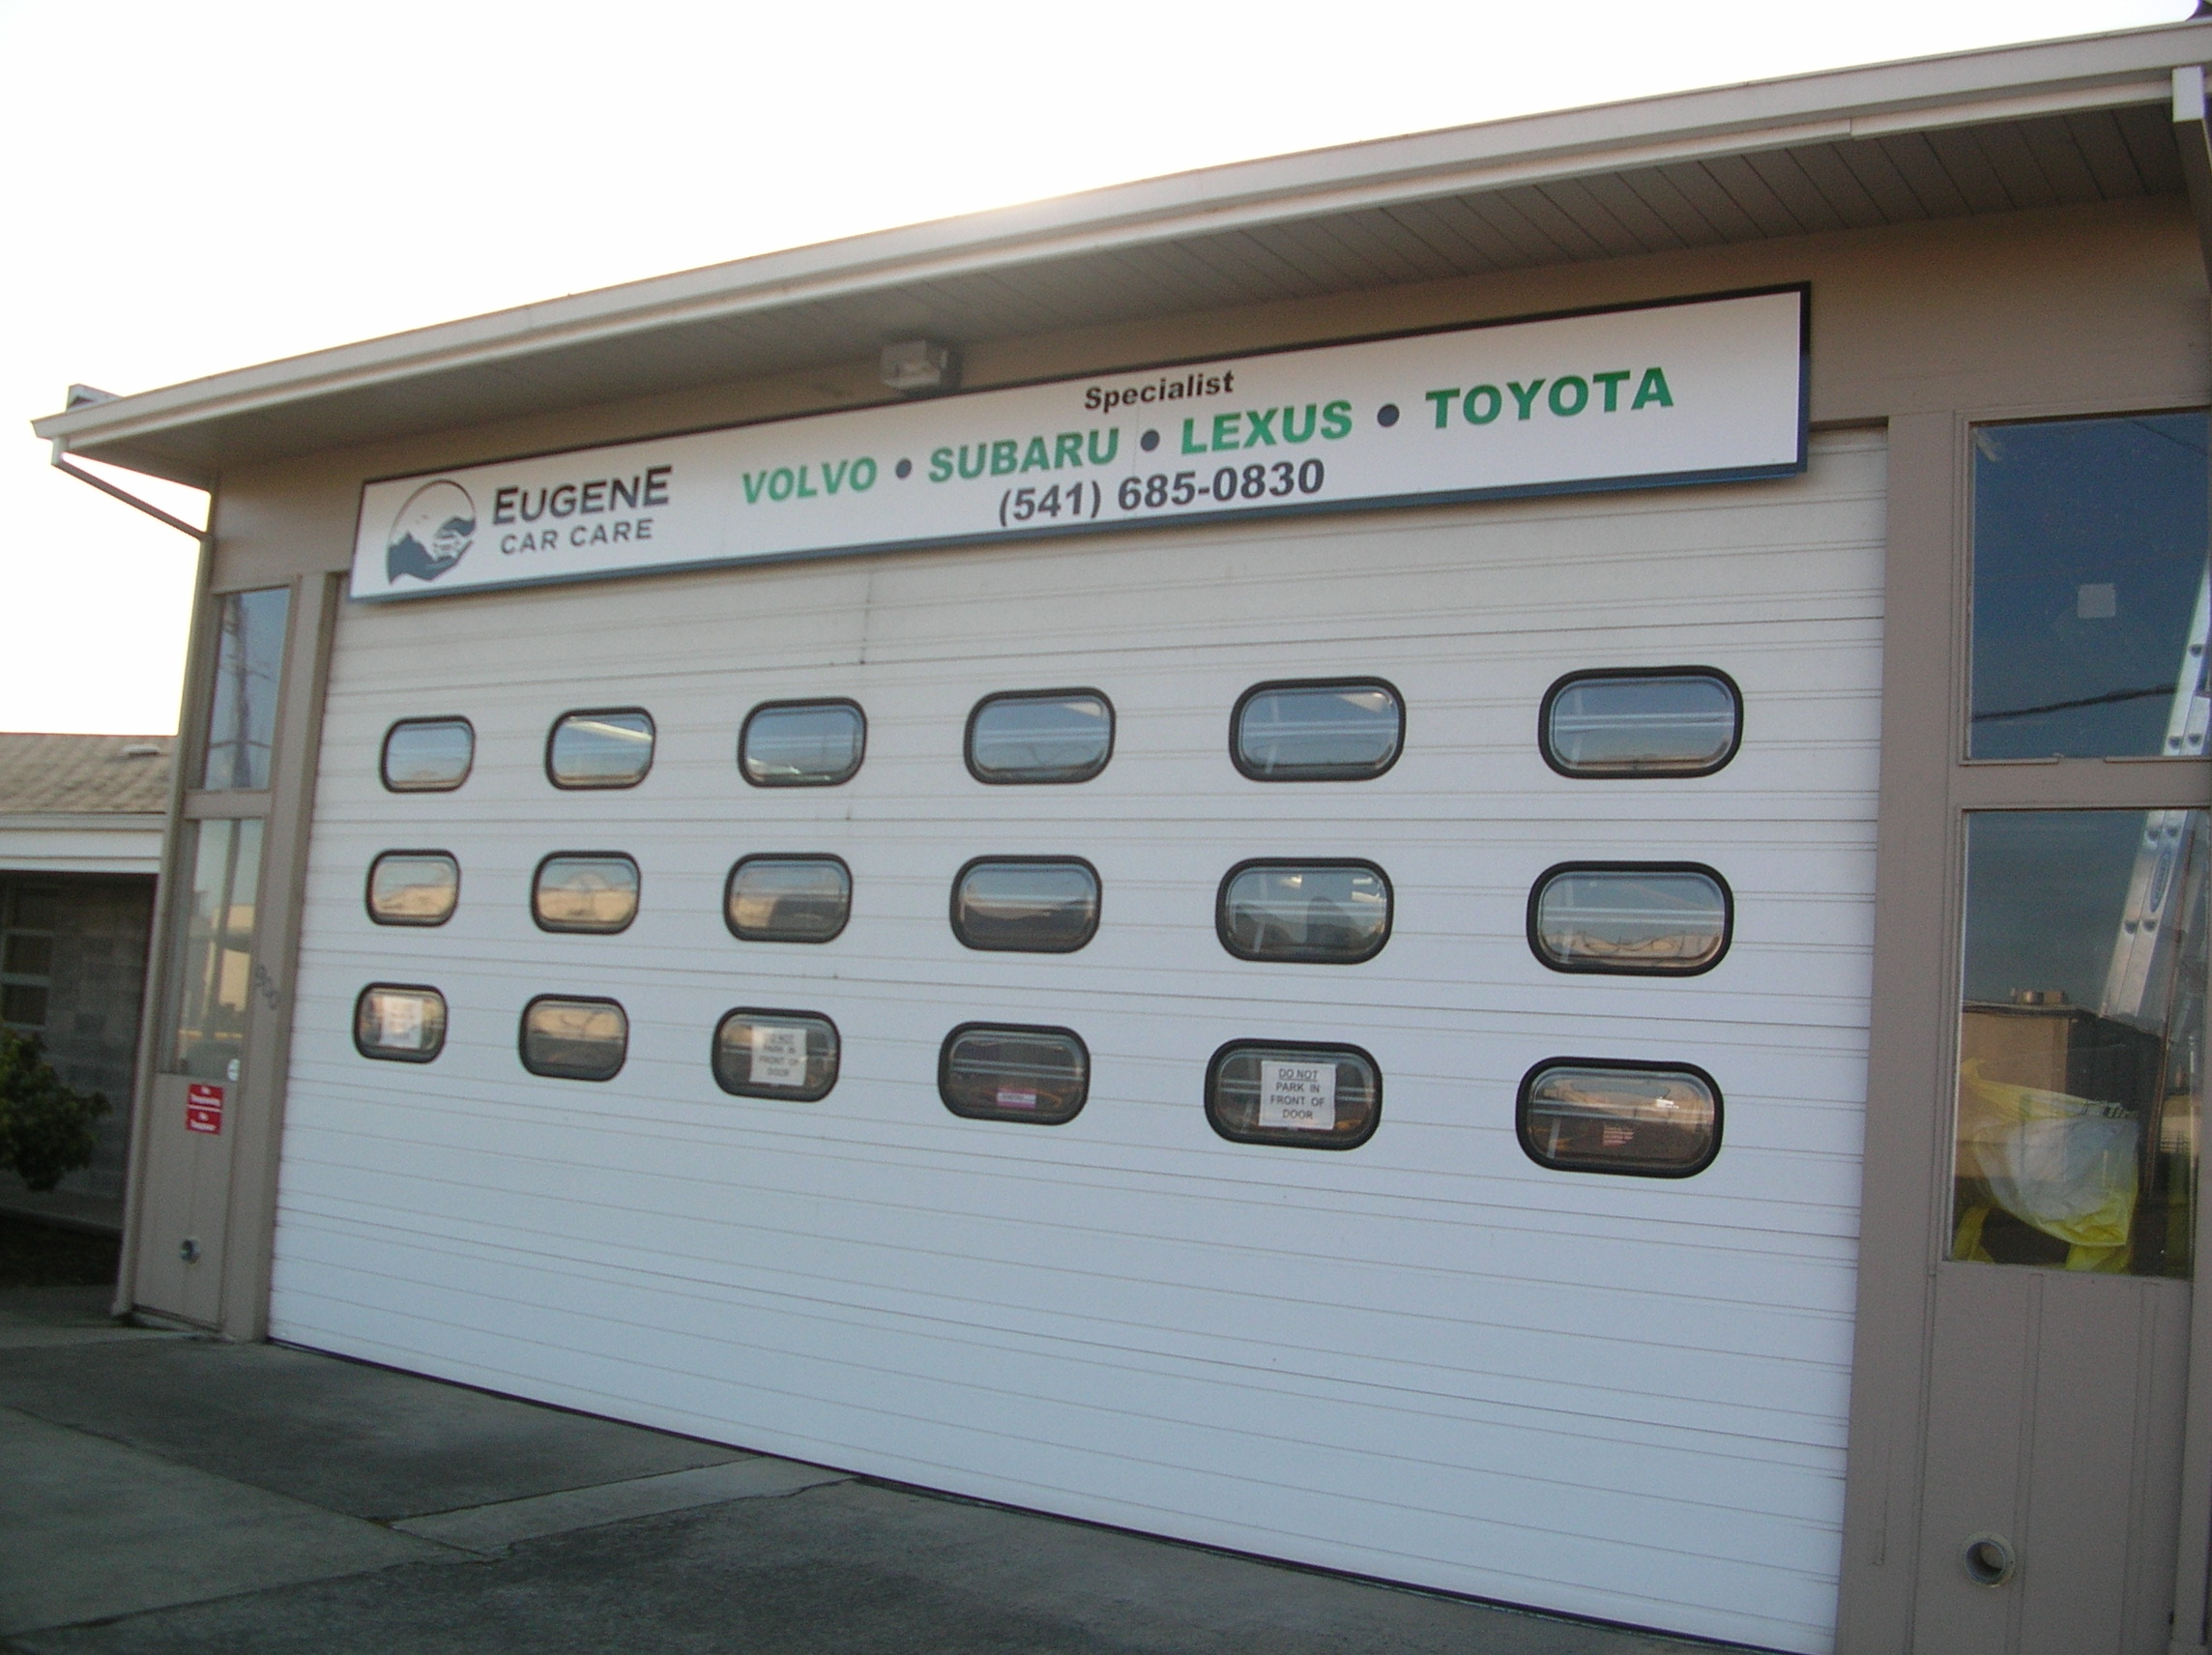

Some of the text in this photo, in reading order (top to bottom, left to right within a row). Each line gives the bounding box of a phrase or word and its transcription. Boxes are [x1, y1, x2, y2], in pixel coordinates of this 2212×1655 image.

[1084, 369, 1235, 413] Specialist
[742, 366, 1674, 505] VOLVO SUBARU LEXUS TOYOTA
[493, 464, 673, 525] EUGENE
[999, 458, 1325, 527] (541) 685-0830
[501, 517, 655, 555] CAR CARE
[1275, 1083, 1321, 1093] PARK IN
[1279, 1068, 1319, 1080] DO NOT
[1270, 1094, 1325, 1107] FRONT OF
[1282, 1109, 1314, 1119] DOOR
